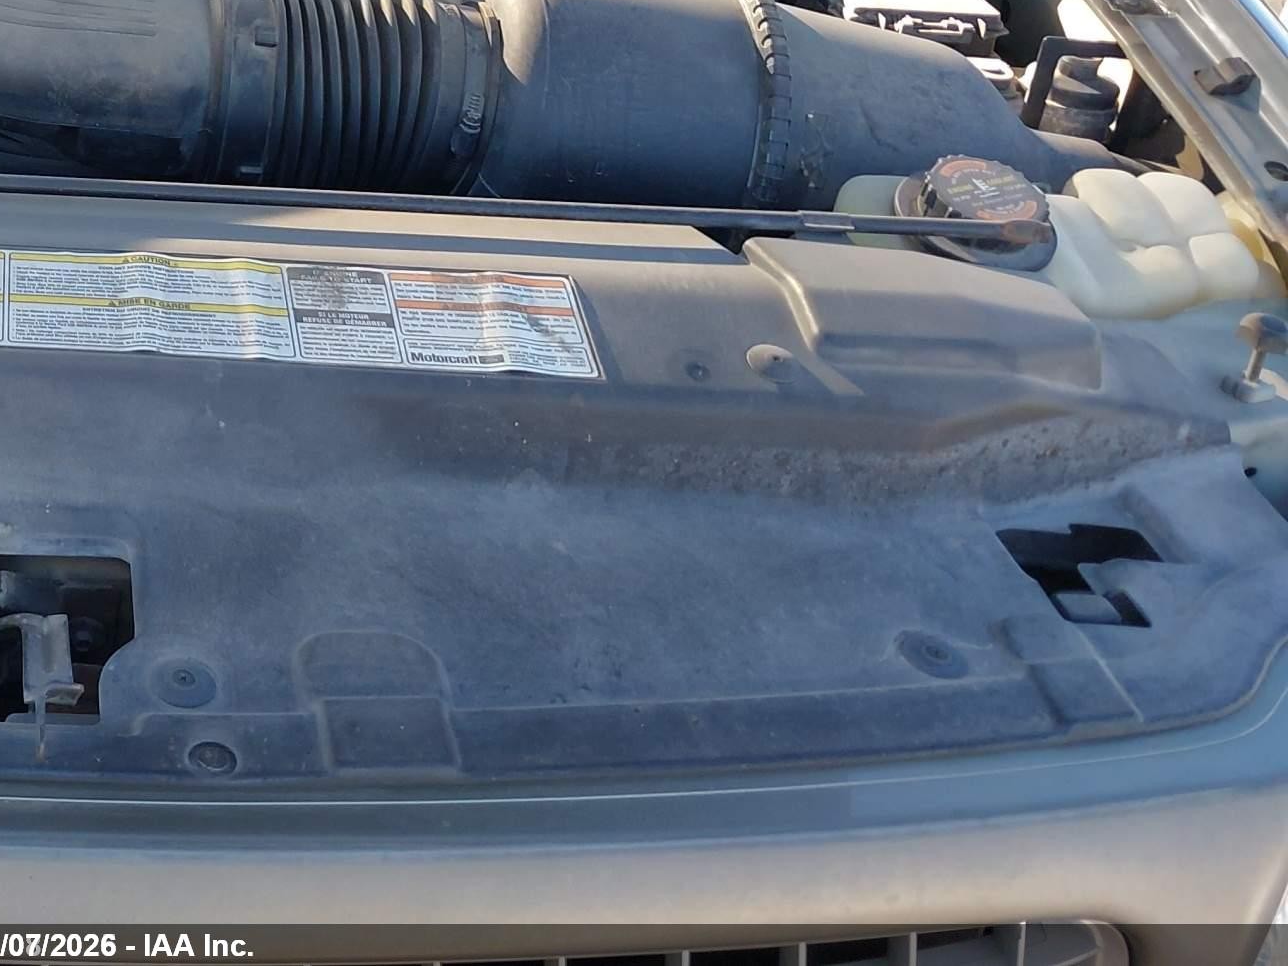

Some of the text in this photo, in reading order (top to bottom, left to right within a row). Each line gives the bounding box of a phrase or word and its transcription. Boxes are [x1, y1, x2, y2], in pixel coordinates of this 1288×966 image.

[131, 256, 172, 267] CAUTION
[118, 297, 191, 310] MISE EN GARDE
[338, 312, 370, 320] MOTEUR
[409, 351, 480, 366] Motorcraft
